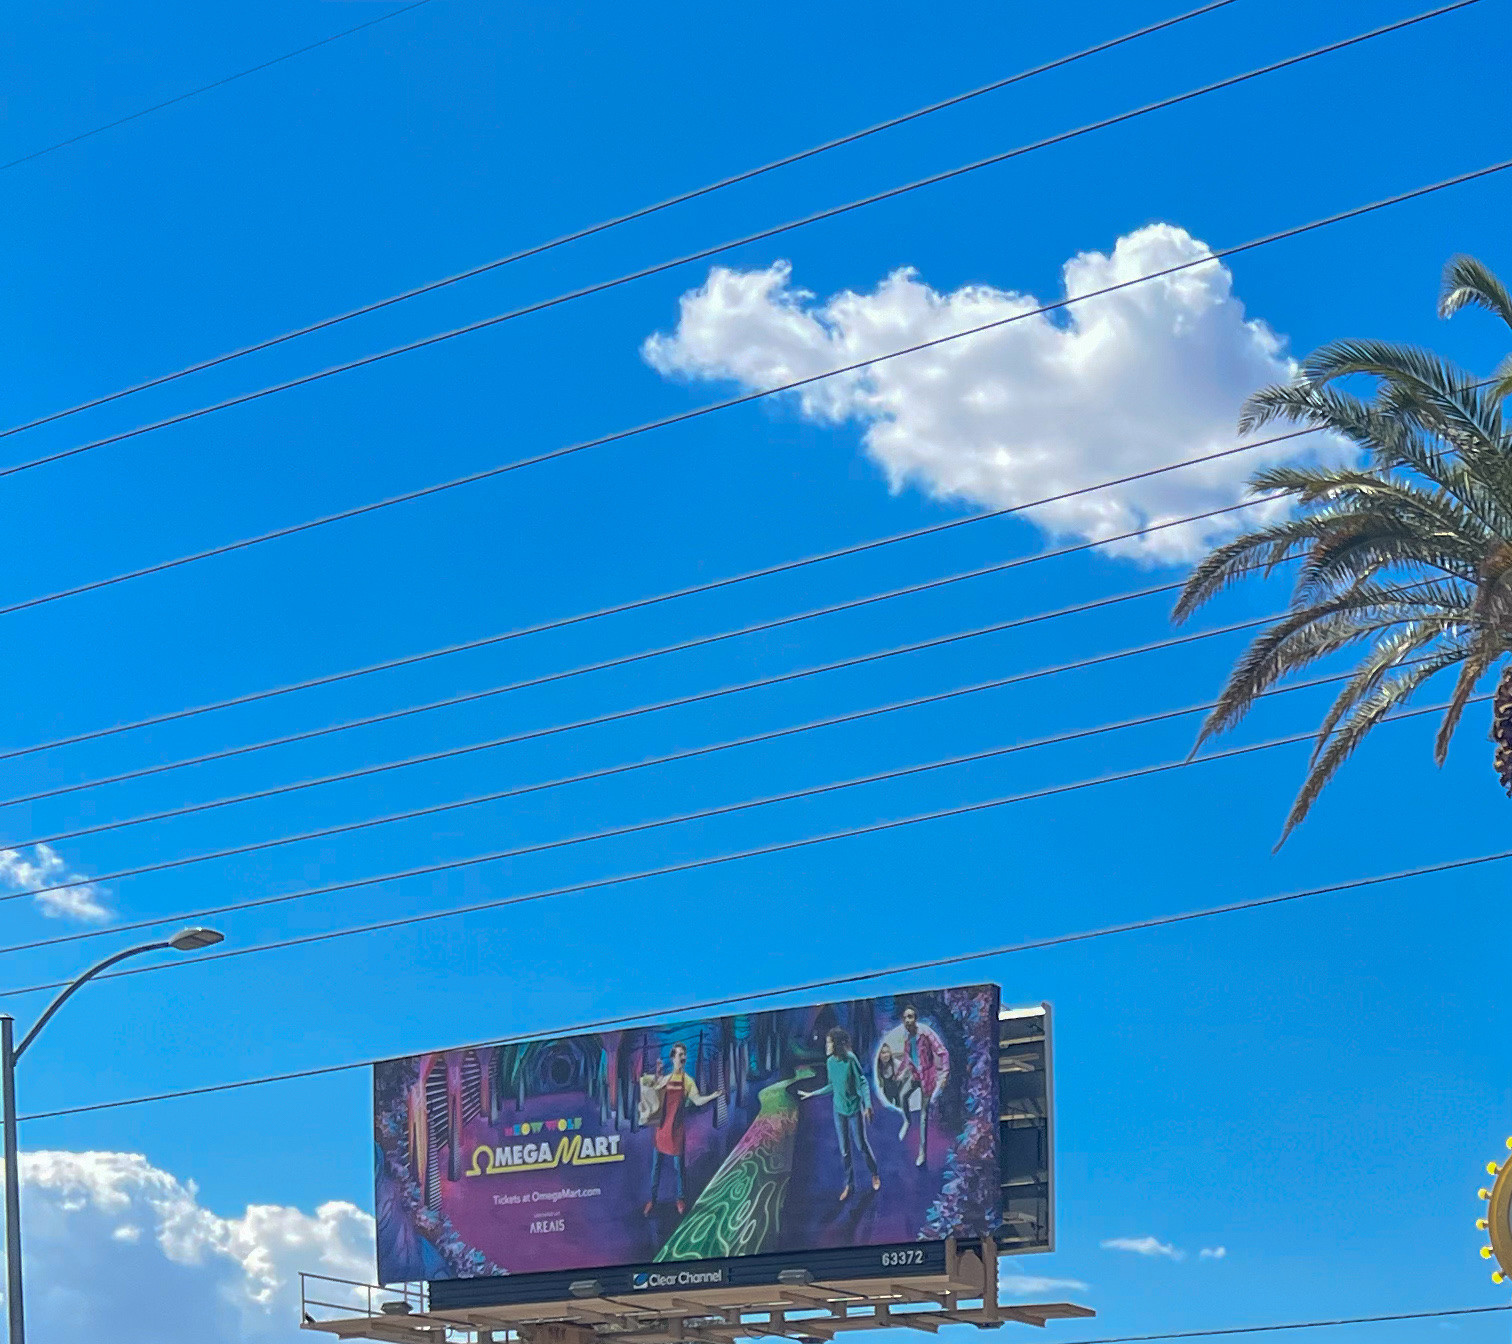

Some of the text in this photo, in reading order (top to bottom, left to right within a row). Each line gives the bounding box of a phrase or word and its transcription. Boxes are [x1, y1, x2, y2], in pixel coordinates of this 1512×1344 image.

[881, 1249, 924, 1267] 63372
[649, 1268, 723, 1287] Clear Channel
